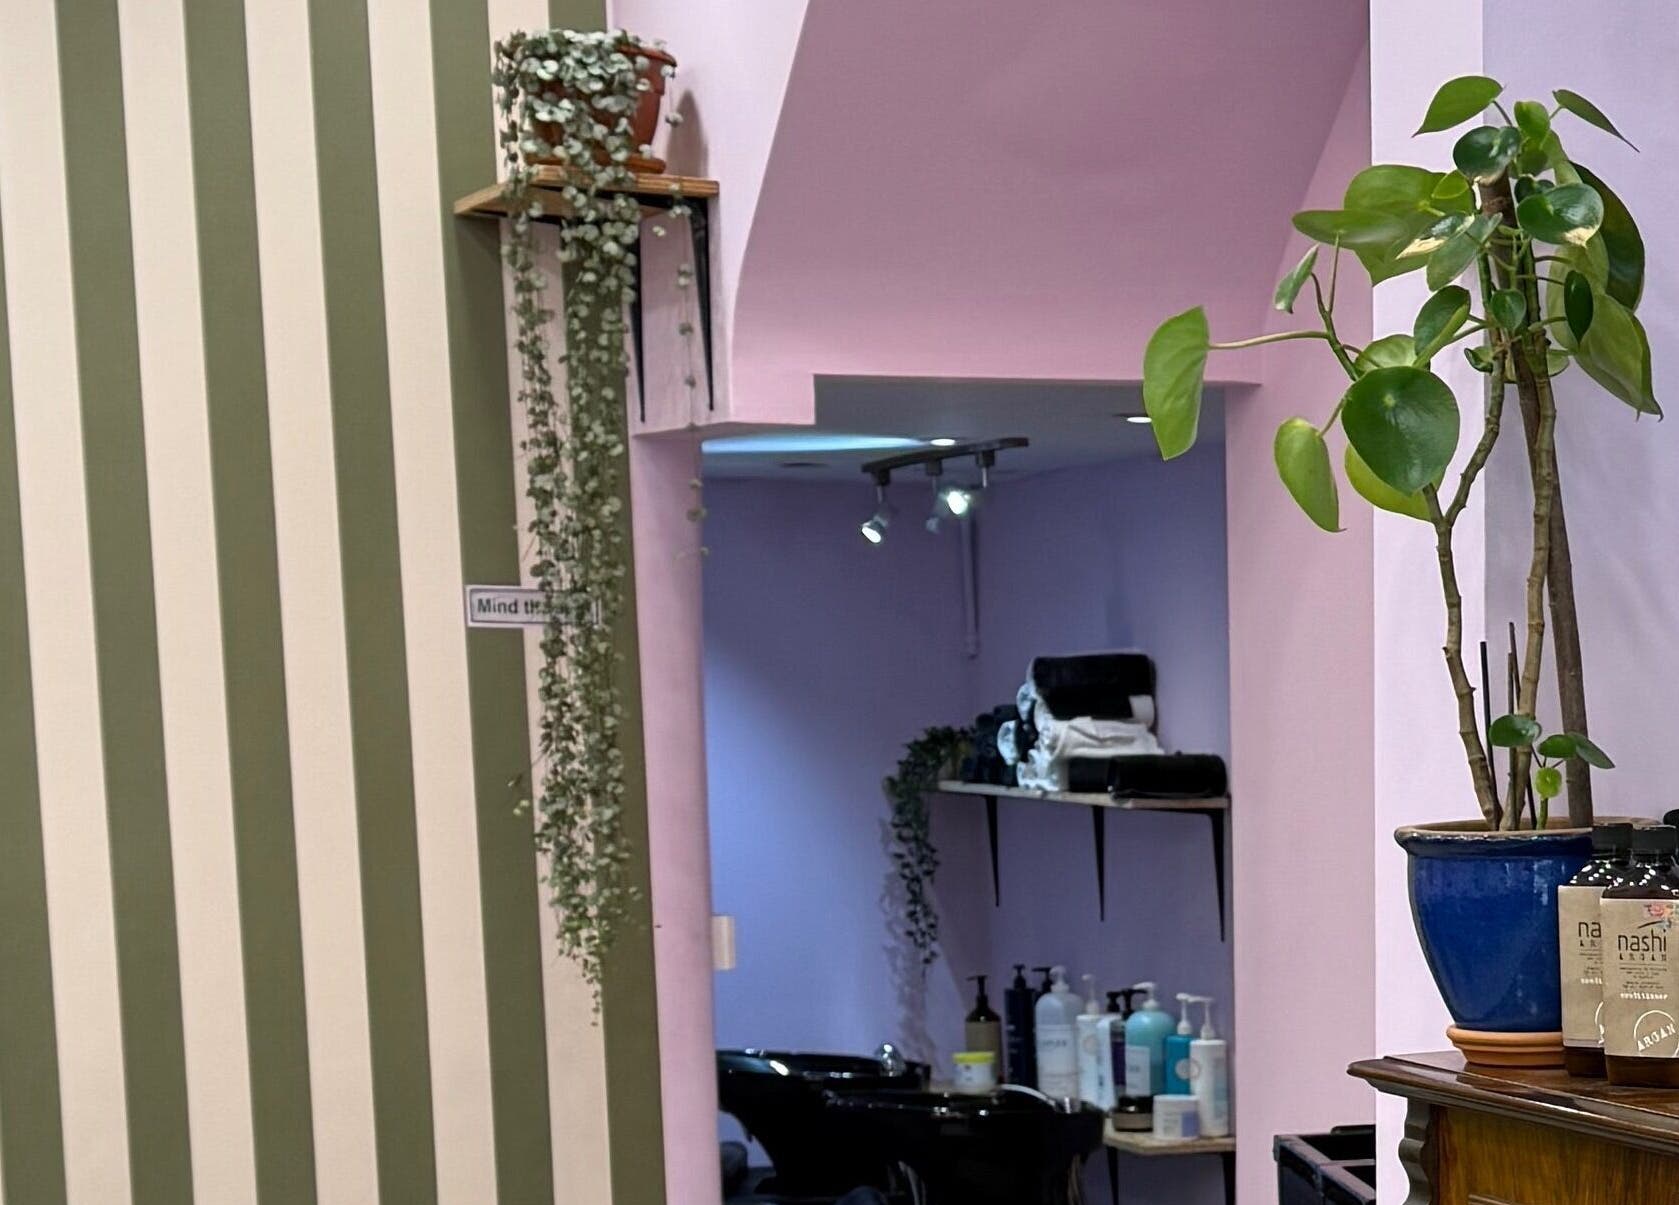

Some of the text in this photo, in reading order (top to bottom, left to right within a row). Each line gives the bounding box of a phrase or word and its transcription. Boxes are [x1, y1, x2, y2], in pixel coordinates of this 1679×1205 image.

[477, 597, 518, 615] Mind
[1617, 928, 1667, 952] nashi
[1637, 1023, 1676, 1052] ARGAN
